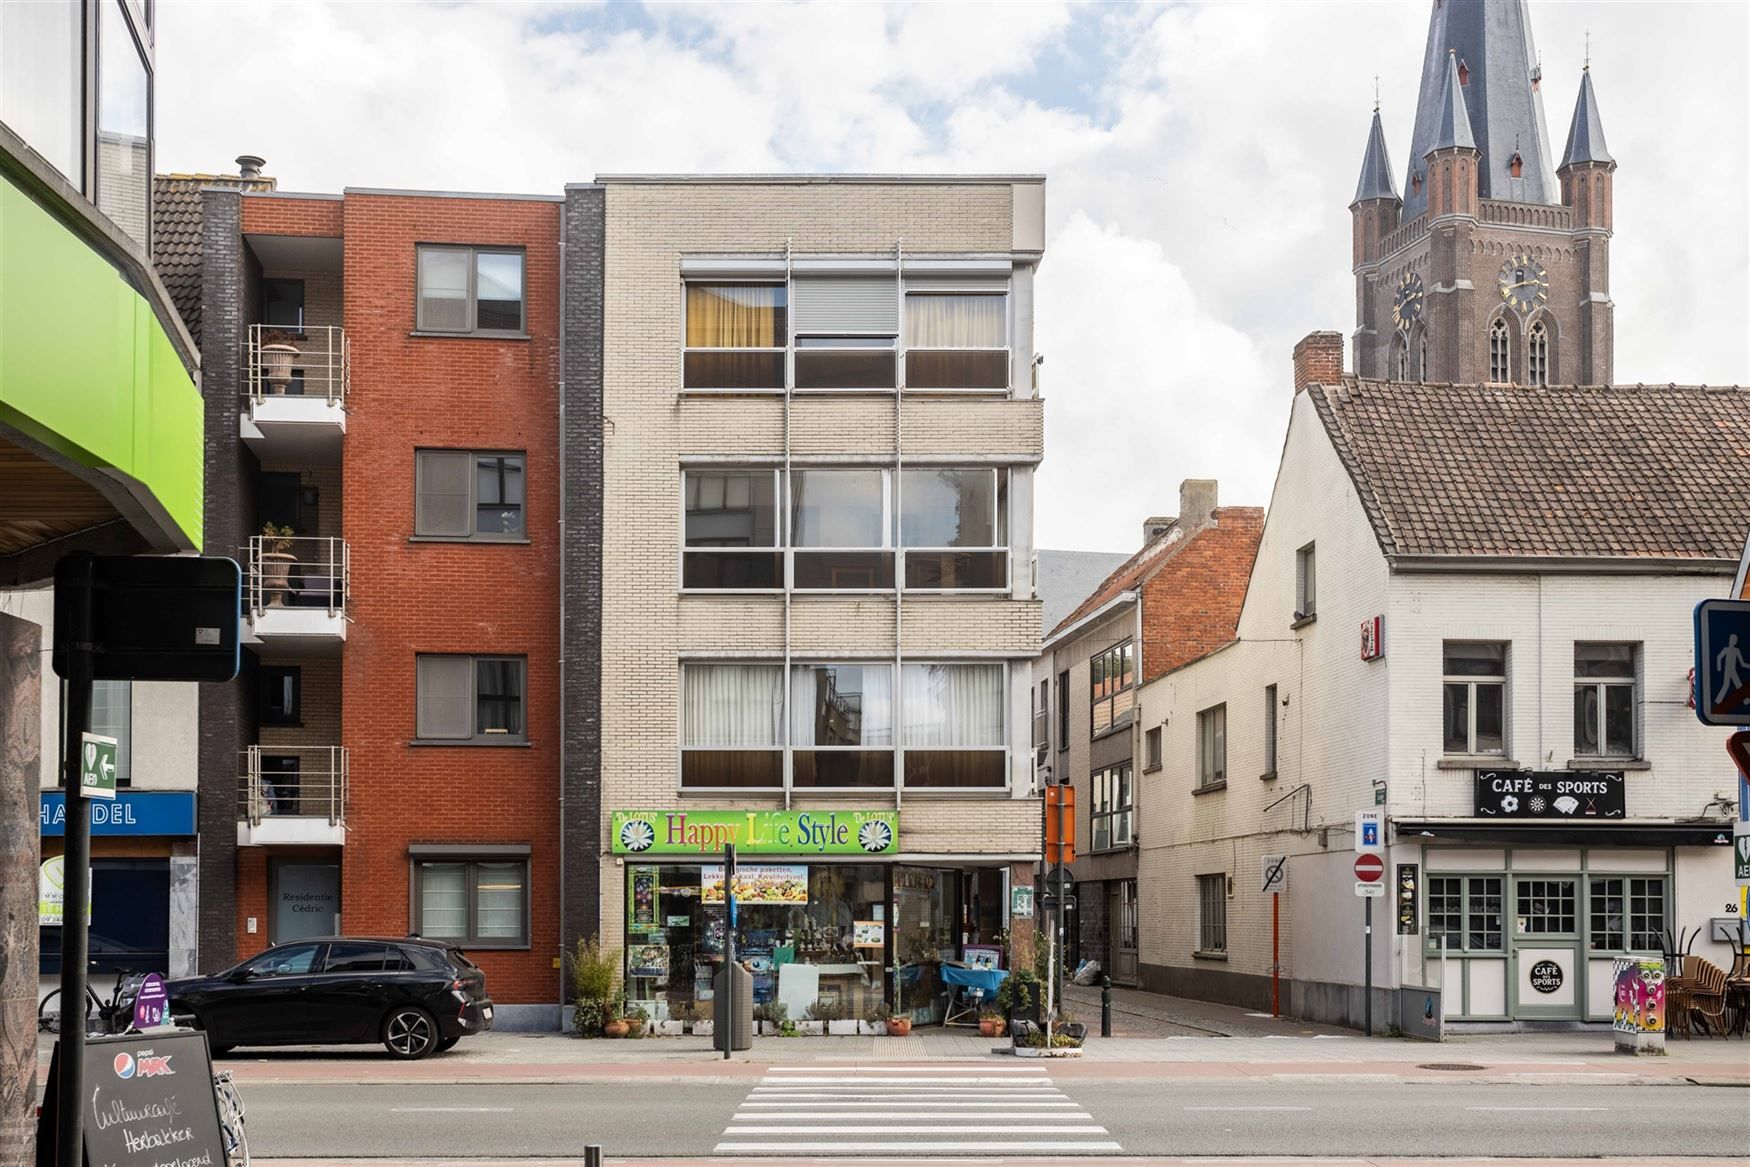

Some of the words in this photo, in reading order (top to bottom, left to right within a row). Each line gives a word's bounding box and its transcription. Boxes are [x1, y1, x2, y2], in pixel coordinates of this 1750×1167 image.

[83, 772, 97, 786] AED
[1492, 778, 1533, 793] CAFÉ
[1556, 781, 1608, 794] SPORTS
[40, 804, 136, 825] HADEL
[665, 812, 741, 852] Happy
[746, 812, 790, 845] Life
[798, 812, 849, 851] Style
[1738, 864, 1750, 877] AE
[283, 893, 333, 901] Residentie
[292, 904, 324, 913] Cédric
[1725, 904, 1738, 913] 26
[1534, 965, 1558, 975] CAFÉ
